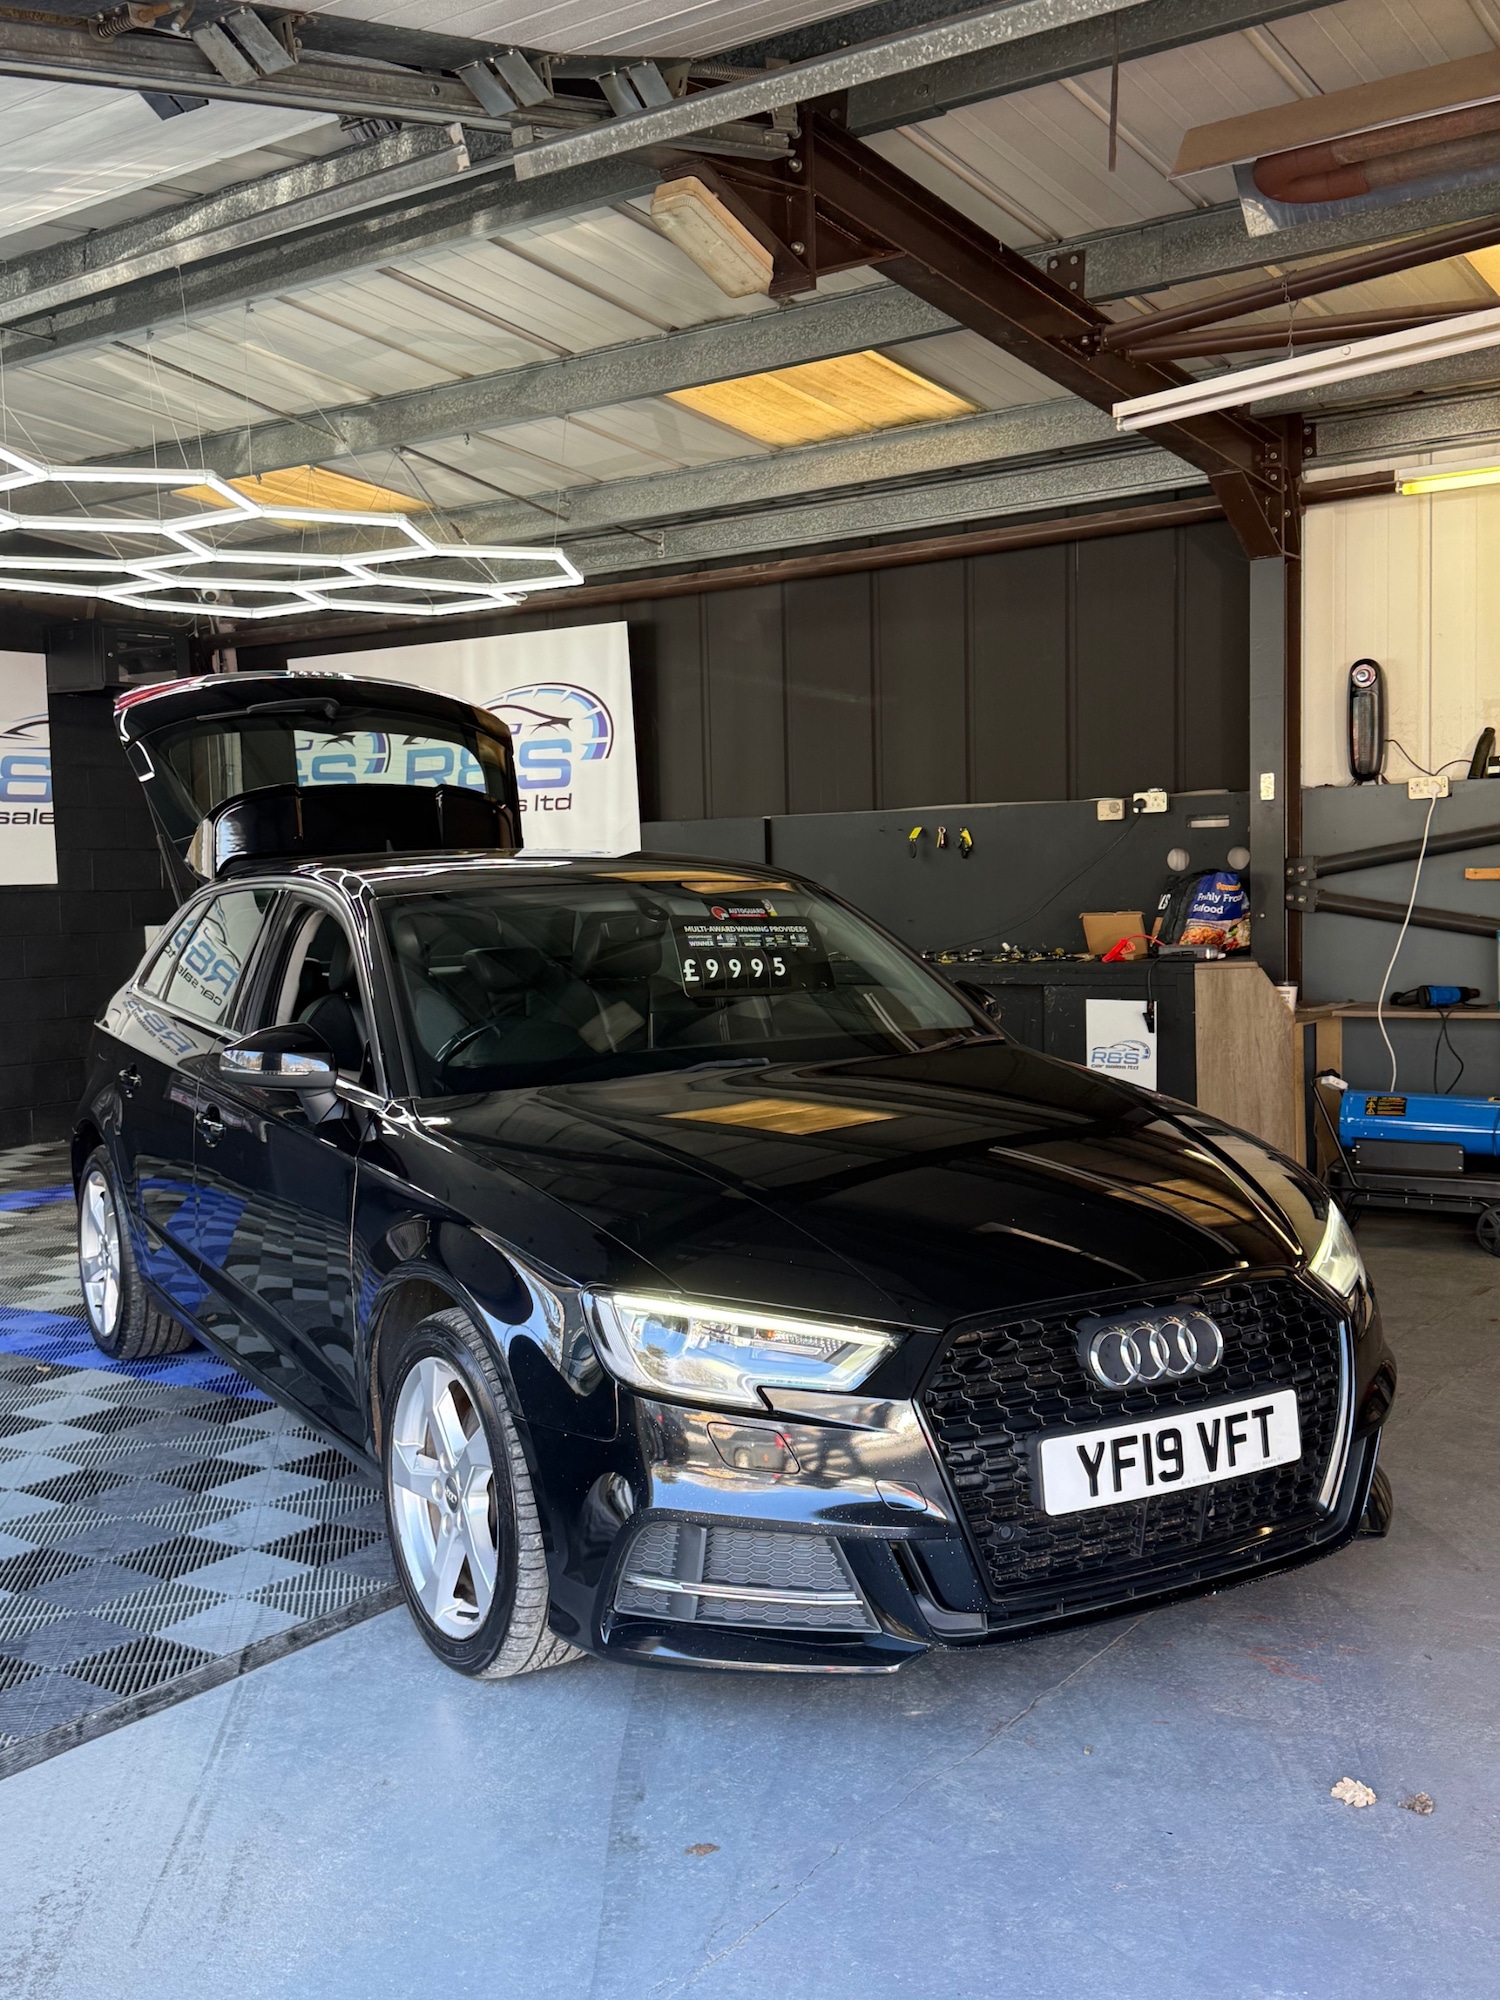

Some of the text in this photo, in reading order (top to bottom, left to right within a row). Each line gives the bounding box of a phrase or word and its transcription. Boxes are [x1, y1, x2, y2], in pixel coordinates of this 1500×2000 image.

[534, 793, 572, 812] ltd
[735, 925, 770, 933] WINNING
[1091, 1051, 1140, 1064] R&S
[1076, 1405, 1274, 1497] YF19 VFT
